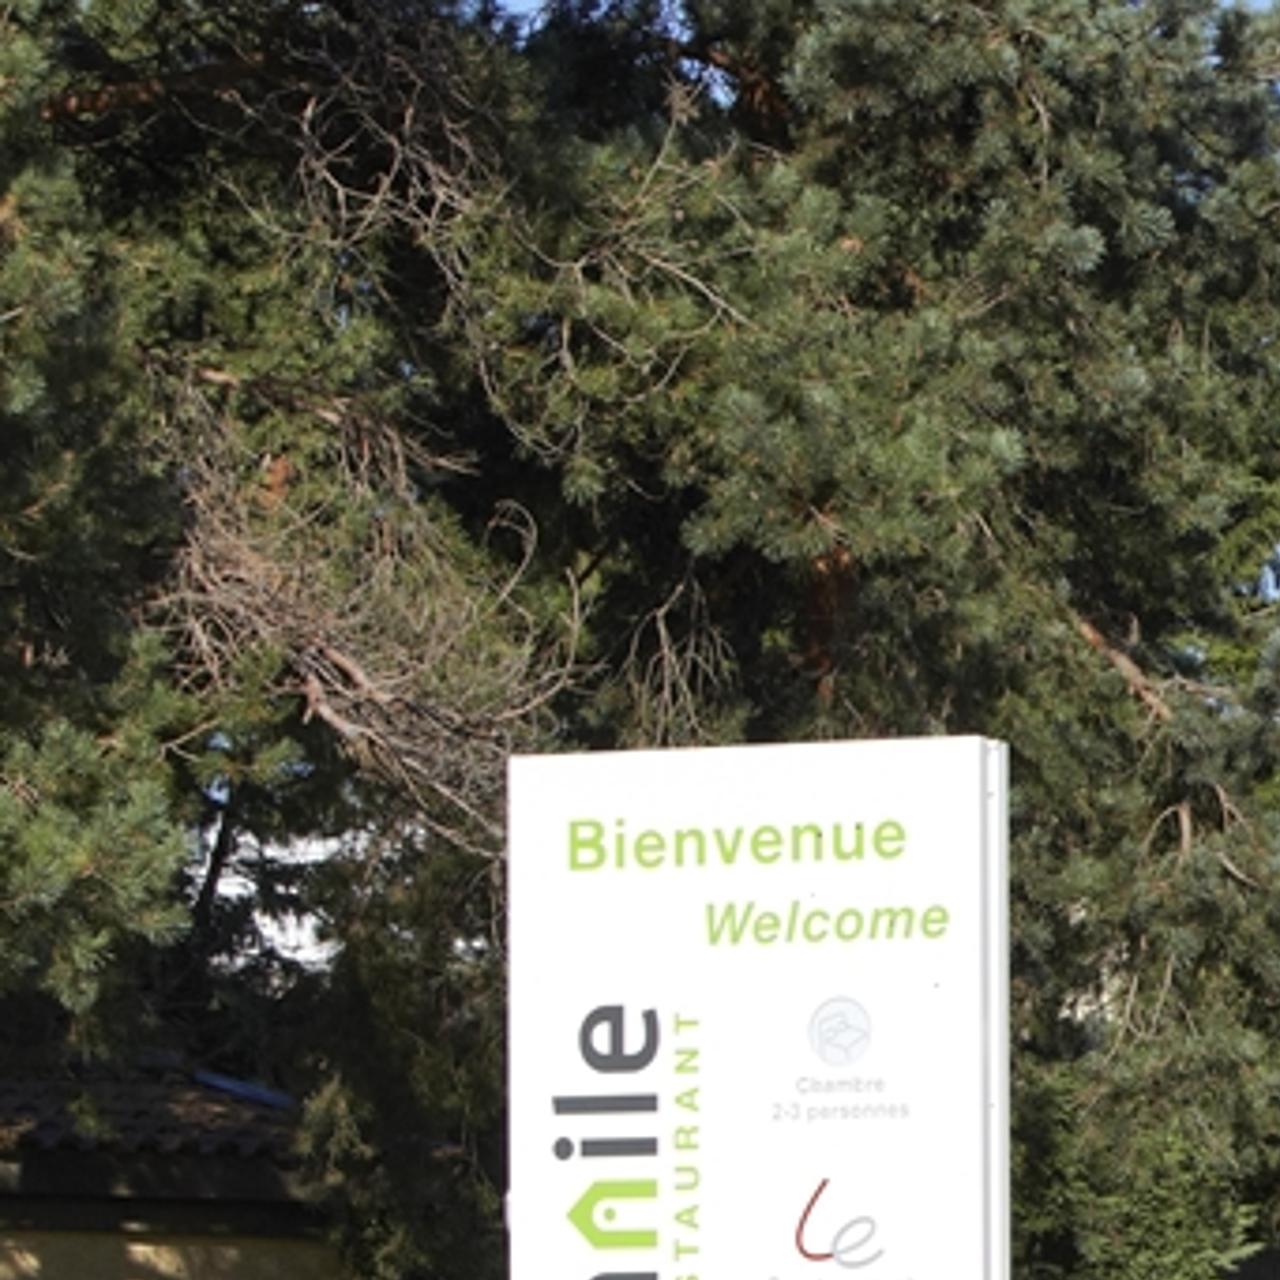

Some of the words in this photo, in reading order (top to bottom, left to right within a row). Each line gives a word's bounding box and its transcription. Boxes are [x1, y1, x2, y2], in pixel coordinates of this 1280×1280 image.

[569, 819, 906, 871] Bienvenue
[706, 902, 950, 945] Welcome
[796, 1076, 886, 1095] Chambre
[807, 1102, 910, 1123] personnes
